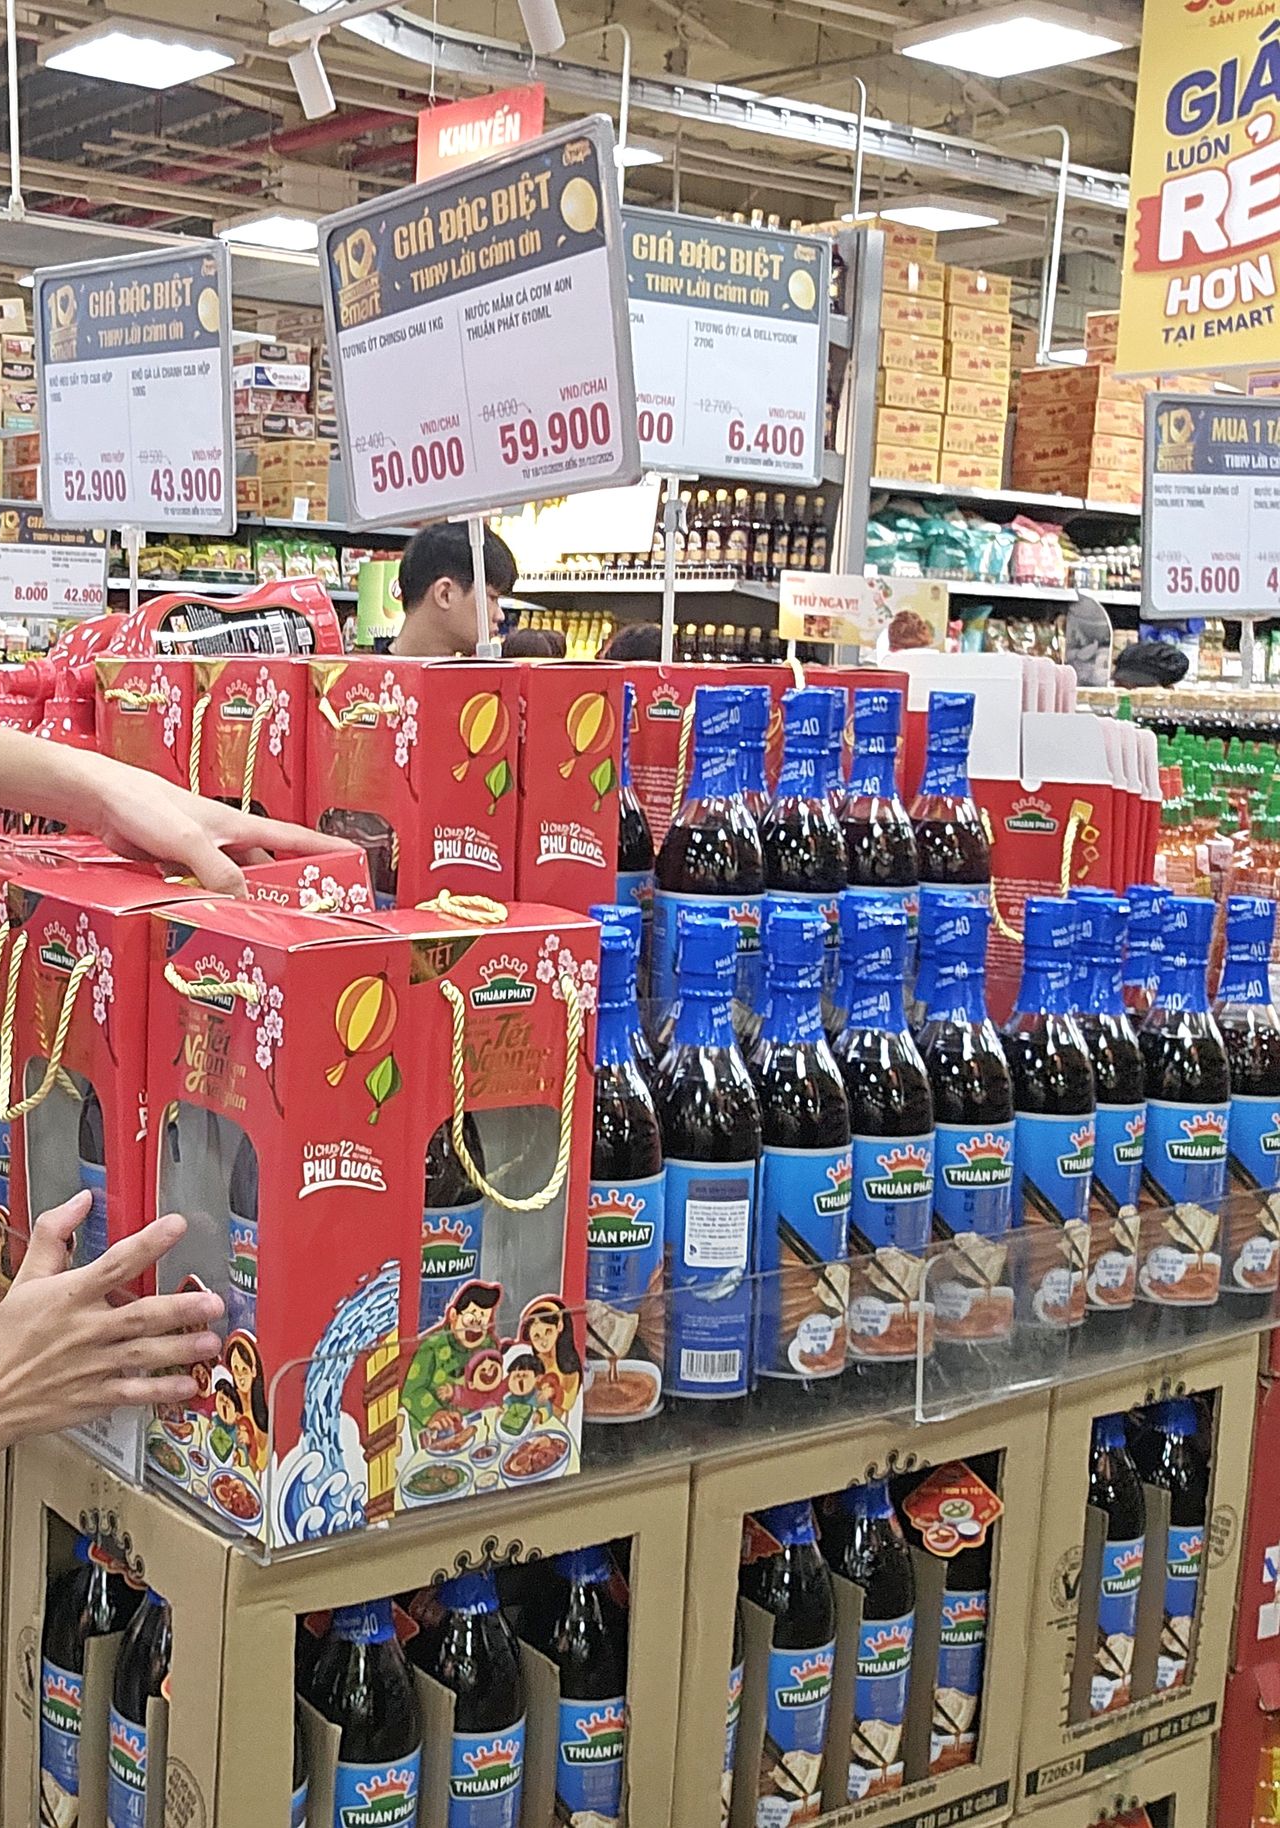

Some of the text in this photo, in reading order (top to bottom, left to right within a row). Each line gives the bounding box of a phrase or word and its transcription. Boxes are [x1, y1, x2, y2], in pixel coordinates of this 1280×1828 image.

[1165, 19, 1280, 136] GIÁ
[438, 104, 520, 157] KHUYẾN
[1166, 133, 1231, 173] LUÔN
[1158, 111, 1280, 262] RẺ
[393, 171, 552, 260] GIÁ ĐẶC BIỆT
[632, 230, 784, 282] GIÁ ĐẶC BIỆT
[411, 264, 449, 293] THAY
[452, 247, 477, 280] LỜI
[88, 273, 194, 318] GIÁ ĐẶC BIỆT
[464, 300, 490, 321] NƯỚC
[530, 282, 552, 301] CƠM
[554, 275, 572, 293] 40N
[645, 273, 683, 293] THAY
[686, 275, 711, 299] LỜI
[1164, 254, 1277, 316] HƠN
[379, 329, 407, 348] CHINSU
[408, 320, 427, 338] CHAI
[429, 316, 443, 333] 1KG
[466, 305, 552, 341] THUẬN PHÁT 610ML
[694, 320, 723, 335] TƯƠNG
[1162, 304, 1275, 348] TẠI EMART
[694, 336, 714, 349] 270G
[559, 377, 608, 401] VND/CHAI
[420, 414, 460, 436] VND/CHAI
[768, 407, 806, 421] VND/CHAI
[499, 401, 611, 465] 59.900
[728, 419, 805, 457] 6.400
[1211, 417, 1249, 443] MUA
[1253, 418, 1261, 443] 1
[371, 436, 465, 493] 50.000
[64, 468, 127, 502] 52.900
[150, 467, 221, 502] 43.900
[1166, 566, 1240, 594] 35.600
[14, 586, 48, 602] 8.000
[63, 587, 103, 603] 42.900
[872, 697, 888, 713] 40
[802, 717, 820, 736] 40
[869, 736, 885, 754] 40
[800, 758, 815, 777] 40
[464, 825, 476, 842] 12
[1175, 911, 1187, 928] 40
[1254, 900, 1270, 917] 40
[955, 915, 970, 936] 40
[878, 991, 890, 1013] 40
[1247, 979, 1263, 998] 40
[362, 1613, 378, 1636] 40
[1040, 1757, 1082, 1787] 720634
